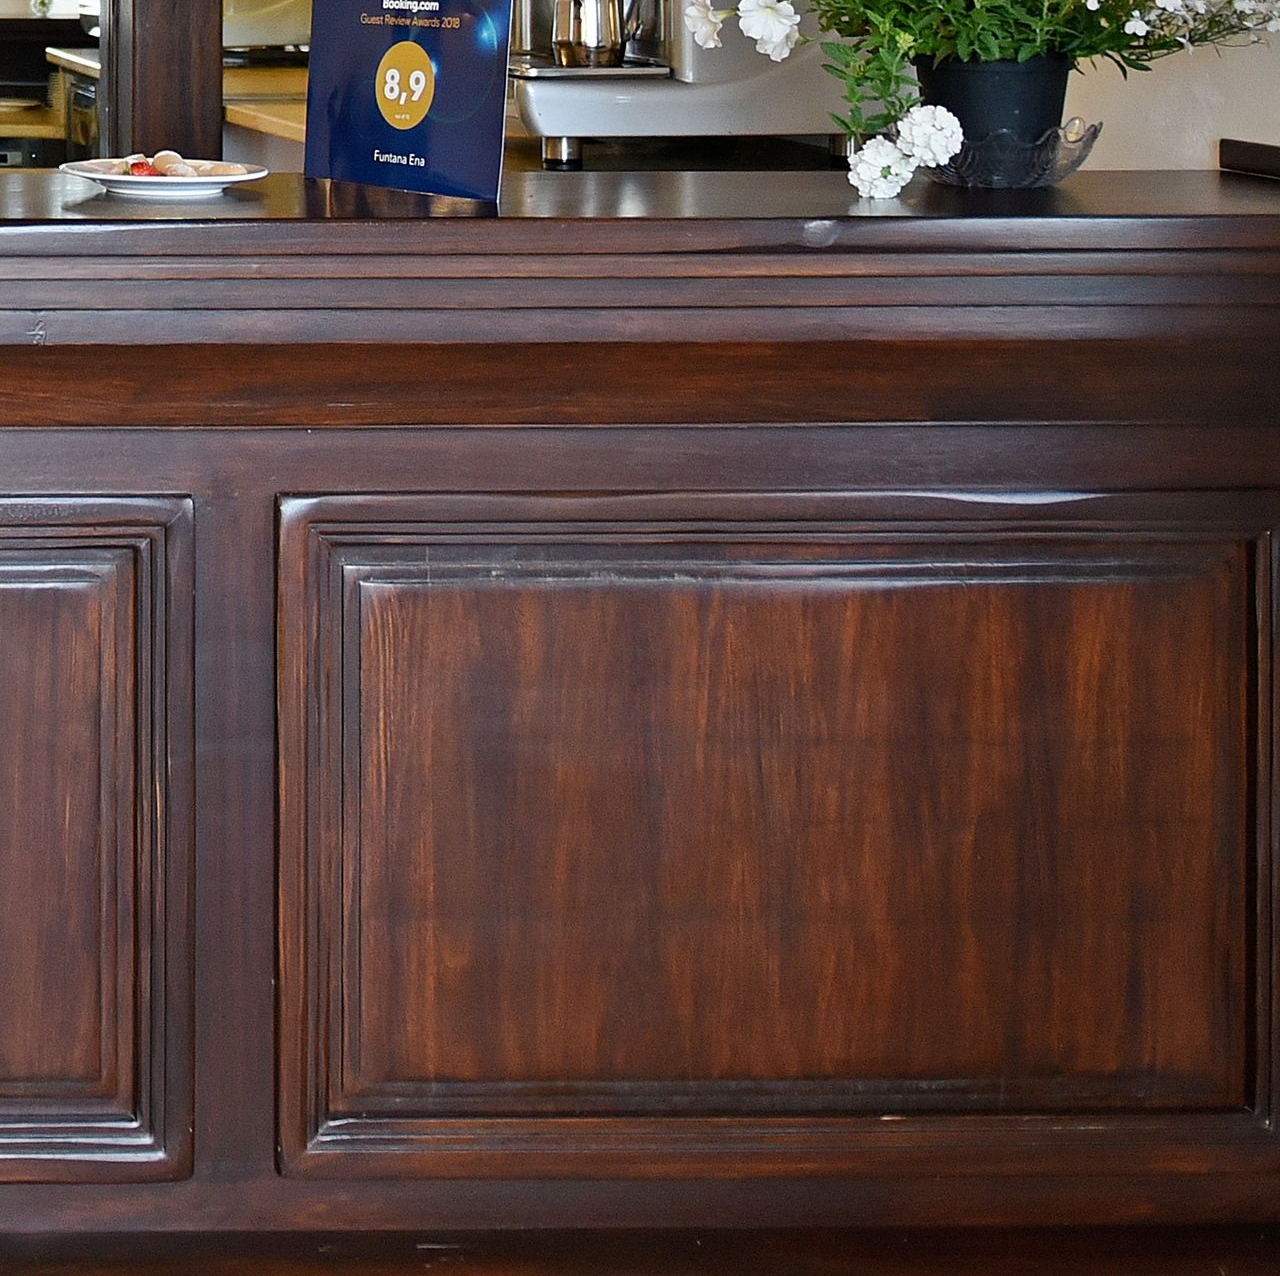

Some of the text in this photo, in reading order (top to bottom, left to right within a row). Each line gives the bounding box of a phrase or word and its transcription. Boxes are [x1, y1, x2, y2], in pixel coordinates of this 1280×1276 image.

[360, 13, 460, 28] Guest Review Awards 2018
[384, 68, 426, 105] 8,9
[373, 150, 426, 166] Funtana Ena
